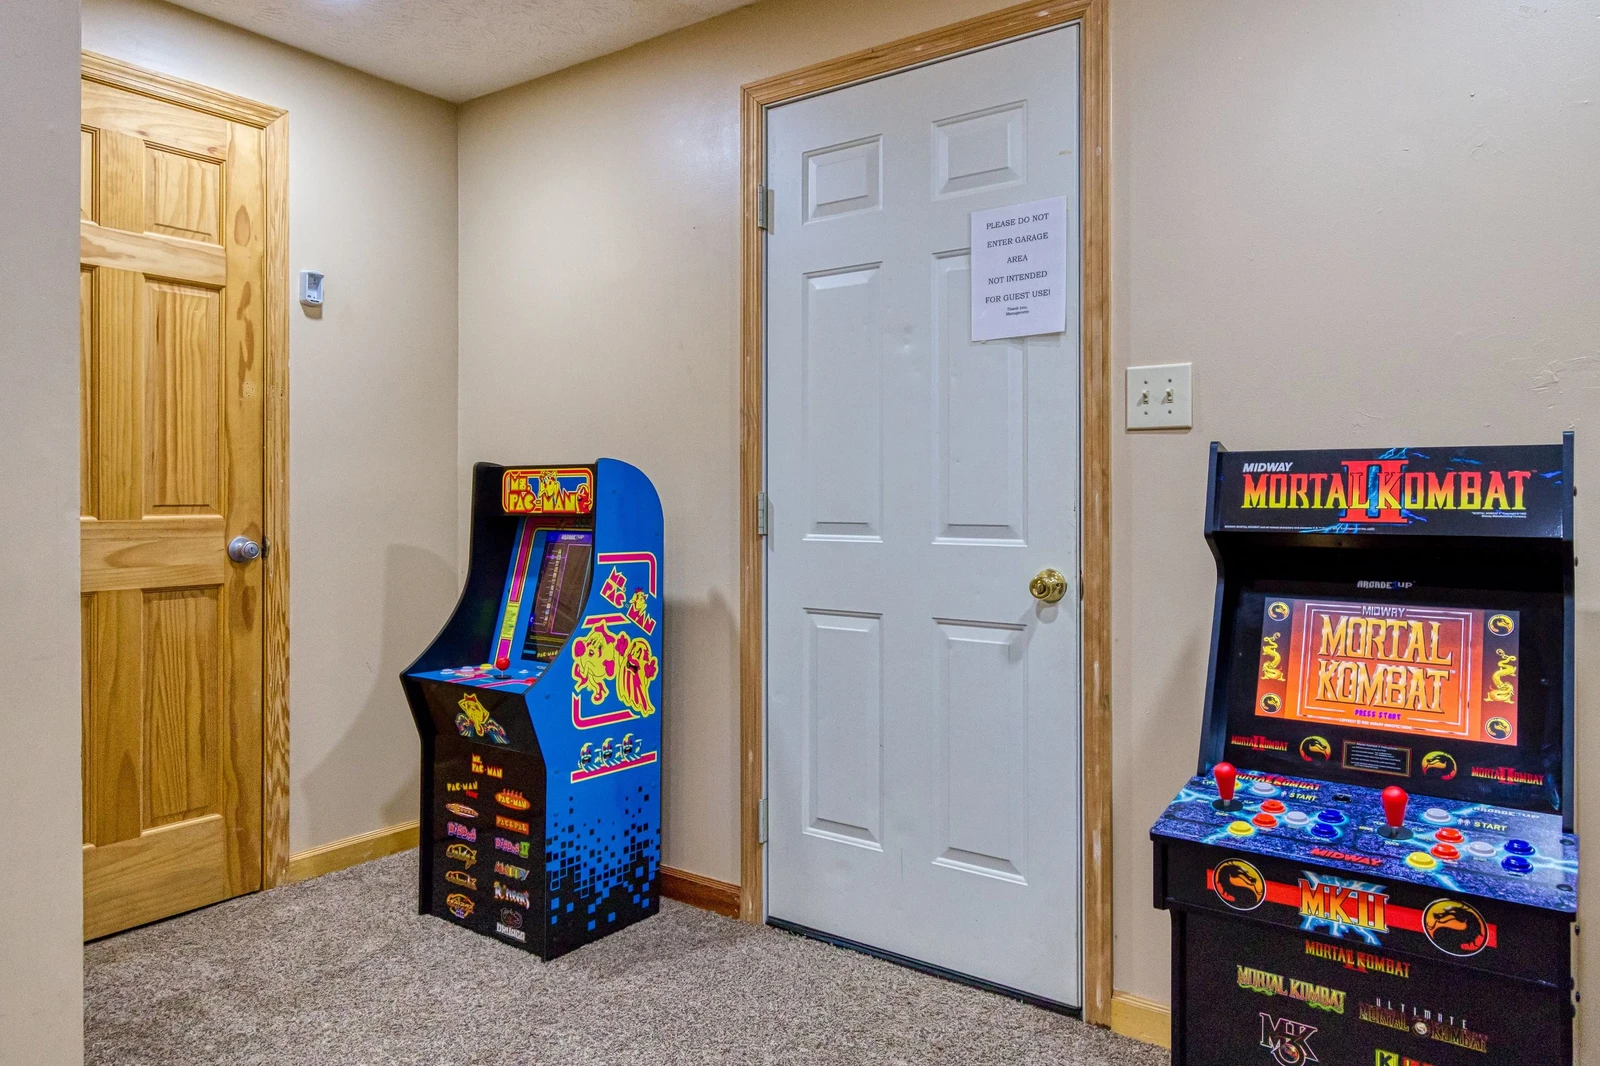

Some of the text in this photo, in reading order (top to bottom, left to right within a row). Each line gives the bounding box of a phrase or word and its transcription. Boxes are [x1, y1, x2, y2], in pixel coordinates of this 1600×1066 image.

[986, 213, 1049, 230] PLEASE DO NOT
[987, 232, 1049, 248] ENTER GARAGE
[1007, 254, 1028, 264] AREA
[988, 270, 1048, 285] NOT INTENDED
[985, 289, 1051, 304] FOR GUEST USE!
[1242, 462, 1293, 472] MIDWAY
[509, 471, 532, 491] MS.
[1241, 471, 1532, 510] MORTAL KOMBAT
[508, 487, 577, 513] PAC-MAN
[1362, 606, 1406, 617] MIDWAY
[1318, 614, 1452, 666] MORTAL
[1315, 658, 1450, 714] KOMBAT
[1354, 709, 1401, 720] PRESS START
[472, 763, 503, 779] PAC-MAN
[1471, 767, 1544, 785] MORTAL KOMBAT
[447, 780, 478, 791] PAC-MAN
[498, 794, 527, 808] PAC-MAN
[1289, 792, 1317, 801] START
[1474, 822, 1507, 831] START
[1311, 848, 1383, 866] MIDWAY
[1305, 939, 1410, 978] MORTAL KOMBAT
[1237, 965, 1346, 1012] MORTAL KOMBAT
[1376, 998, 1468, 1029] ULTIMATE
